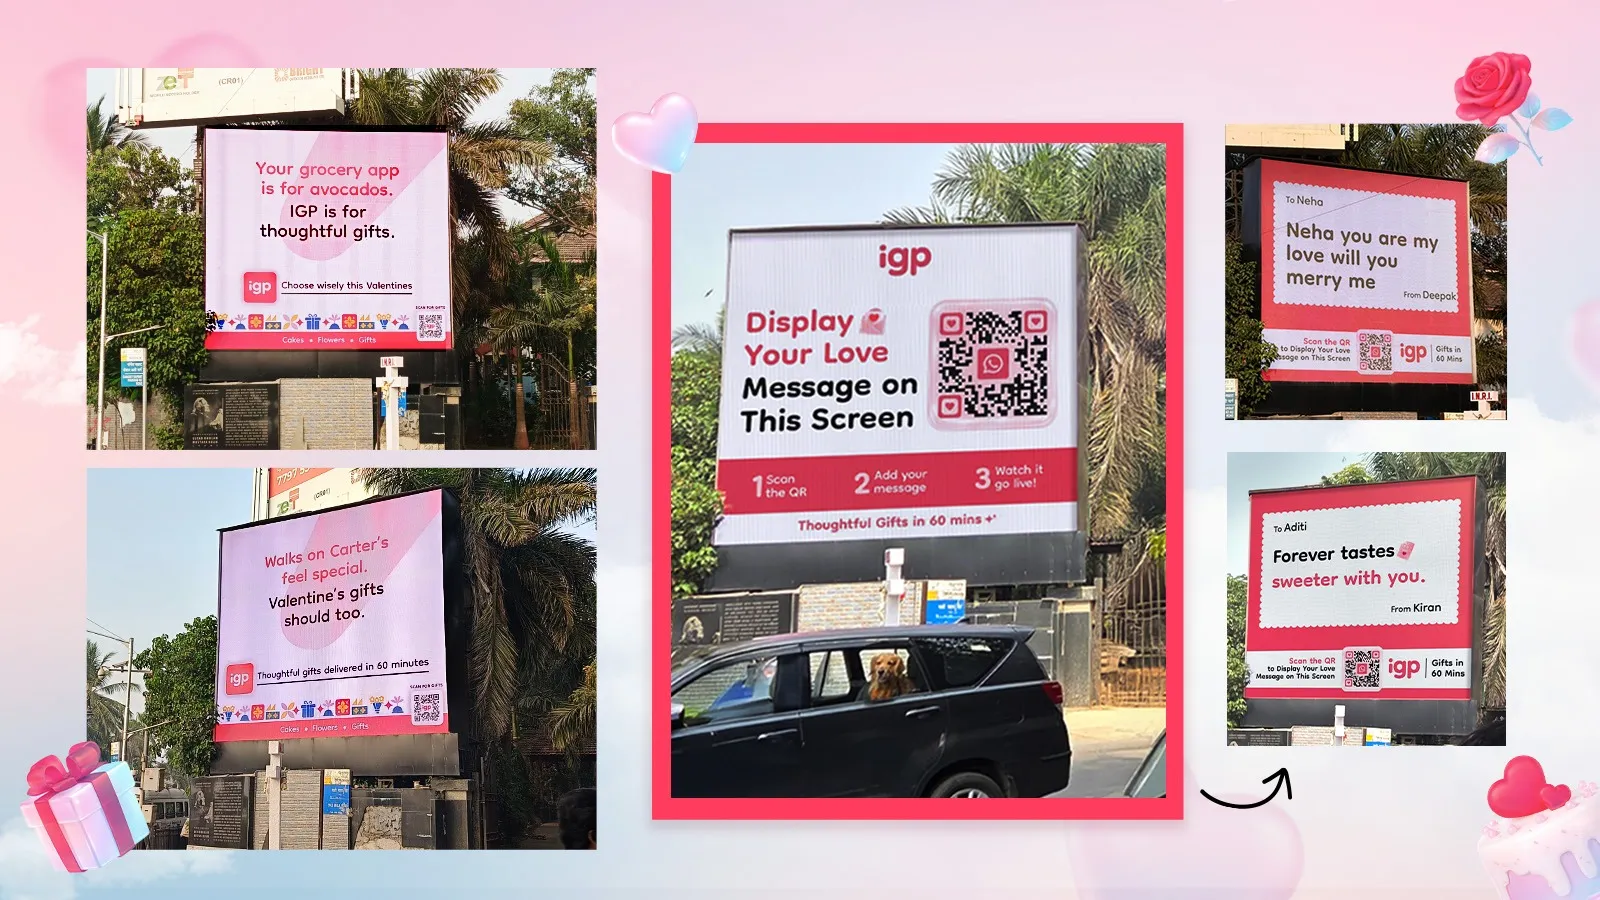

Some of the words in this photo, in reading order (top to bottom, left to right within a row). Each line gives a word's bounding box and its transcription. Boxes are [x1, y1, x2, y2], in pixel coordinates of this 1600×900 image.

[218, 77, 244, 86] (CR01)
[256, 162, 294, 176] Your
[300, 164, 362, 180] grocery
[368, 165, 399, 180] app
[261, 181, 274, 195] is
[280, 181, 304, 195] for
[310, 182, 393, 196] avocados.
[1286, 196, 1295, 204] To
[1296, 195, 1324, 206] Neha
[290, 204, 318, 218] IGP
[324, 204, 337, 218] is
[342, 204, 366, 218] for
[260, 224, 347, 241] thoughtful
[353, 224, 395, 242] gifts.
[1286, 222, 1334, 241] Neha
[1340, 230, 1372, 246] you
[1378, 232, 1407, 246] are
[1413, 236, 1438, 253] my
[879, 244, 932, 277] igp
[1286, 244, 1324, 263] love
[1331, 249, 1360, 265] will
[1367, 255, 1398, 271] you
[248, 280, 272, 294] igp
[281, 282, 314, 290] Choose
[317, 282, 344, 291] wisely
[347, 282, 363, 290] this
[367, 282, 413, 290] Valentines
[1286, 272, 1342, 292] merry
[1349, 276, 1376, 289] me
[1403, 291, 1421, 299] From
[1422, 290, 1456, 302] Deepak
[746, 308, 854, 339] Display
[1339, 338, 1350, 346] QR
[1436, 345, 1452, 353] Gifts
[744, 344, 813, 366] Your
[824, 342, 889, 364] Love
[1290, 345, 1316, 354] Display
[1317, 346, 1333, 354] Your
[1400, 343, 1427, 363] igp
[1327, 354, 1350, 362] Screen
[743, 376, 871, 403] Message
[882, 377, 918, 395] on
[740, 408, 801, 433] This
[811, 408, 914, 430] Screen
[874, 470, 898, 480] Add
[901, 471, 928, 483] your
[995, 466, 1031, 476] Watch
[1035, 464, 1043, 474] it
[766, 474, 795, 485] Scan
[854, 472, 870, 495] 2
[974, 467, 991, 489] 3
[994, 481, 1010, 492] go
[1013, 478, 1037, 488] live!
[752, 475, 763, 498] 1
[765, 488, 786, 498] the
[789, 487, 807, 498] QR
[874, 484, 927, 495] message
[798, 518, 871, 533] Thoughtful
[876, 516, 908, 528] Gifts
[913, 516, 925, 527] in
[929, 515, 946, 526] 60
[950, 514, 982, 525] mins
[1284, 522, 1307, 532] Aditi
[265, 552, 303, 568] Walks
[307, 550, 325, 561] on
[1273, 549, 1335, 563] Forever
[1341, 544, 1395, 560] tastes
[282, 569, 307, 584] feel
[312, 560, 368, 582] special.
[1272, 572, 1338, 588] sweeter
[1344, 570, 1381, 585] with
[1388, 571, 1426, 588] you.
[350, 583, 384, 602] gifts
[1391, 605, 1411, 613] From
[1413, 603, 1442, 613] Kiran
[284, 608, 330, 626] should
[335, 608, 365, 620] too.
[1324, 657, 1336, 665] QR
[1432, 659, 1453, 667] Gifts
[1456, 659, 1463, 667] in
[258, 667, 300, 680] Thoughtful
[303, 667, 322, 678] gifts
[324, 663, 363, 674] delivered
[366, 662, 374, 671] in
[377, 661, 388, 670] 60
[391, 658, 429, 669] minutes
[1276, 665, 1301, 673] Display
[1388, 658, 1420, 679] igp
[1444, 669, 1465, 677] Mins
[230, 673, 249, 686] igp
[1256, 673, 1284, 681] Message
[312, 724, 338, 732] Flowers
[351, 722, 369, 730] Gifts
